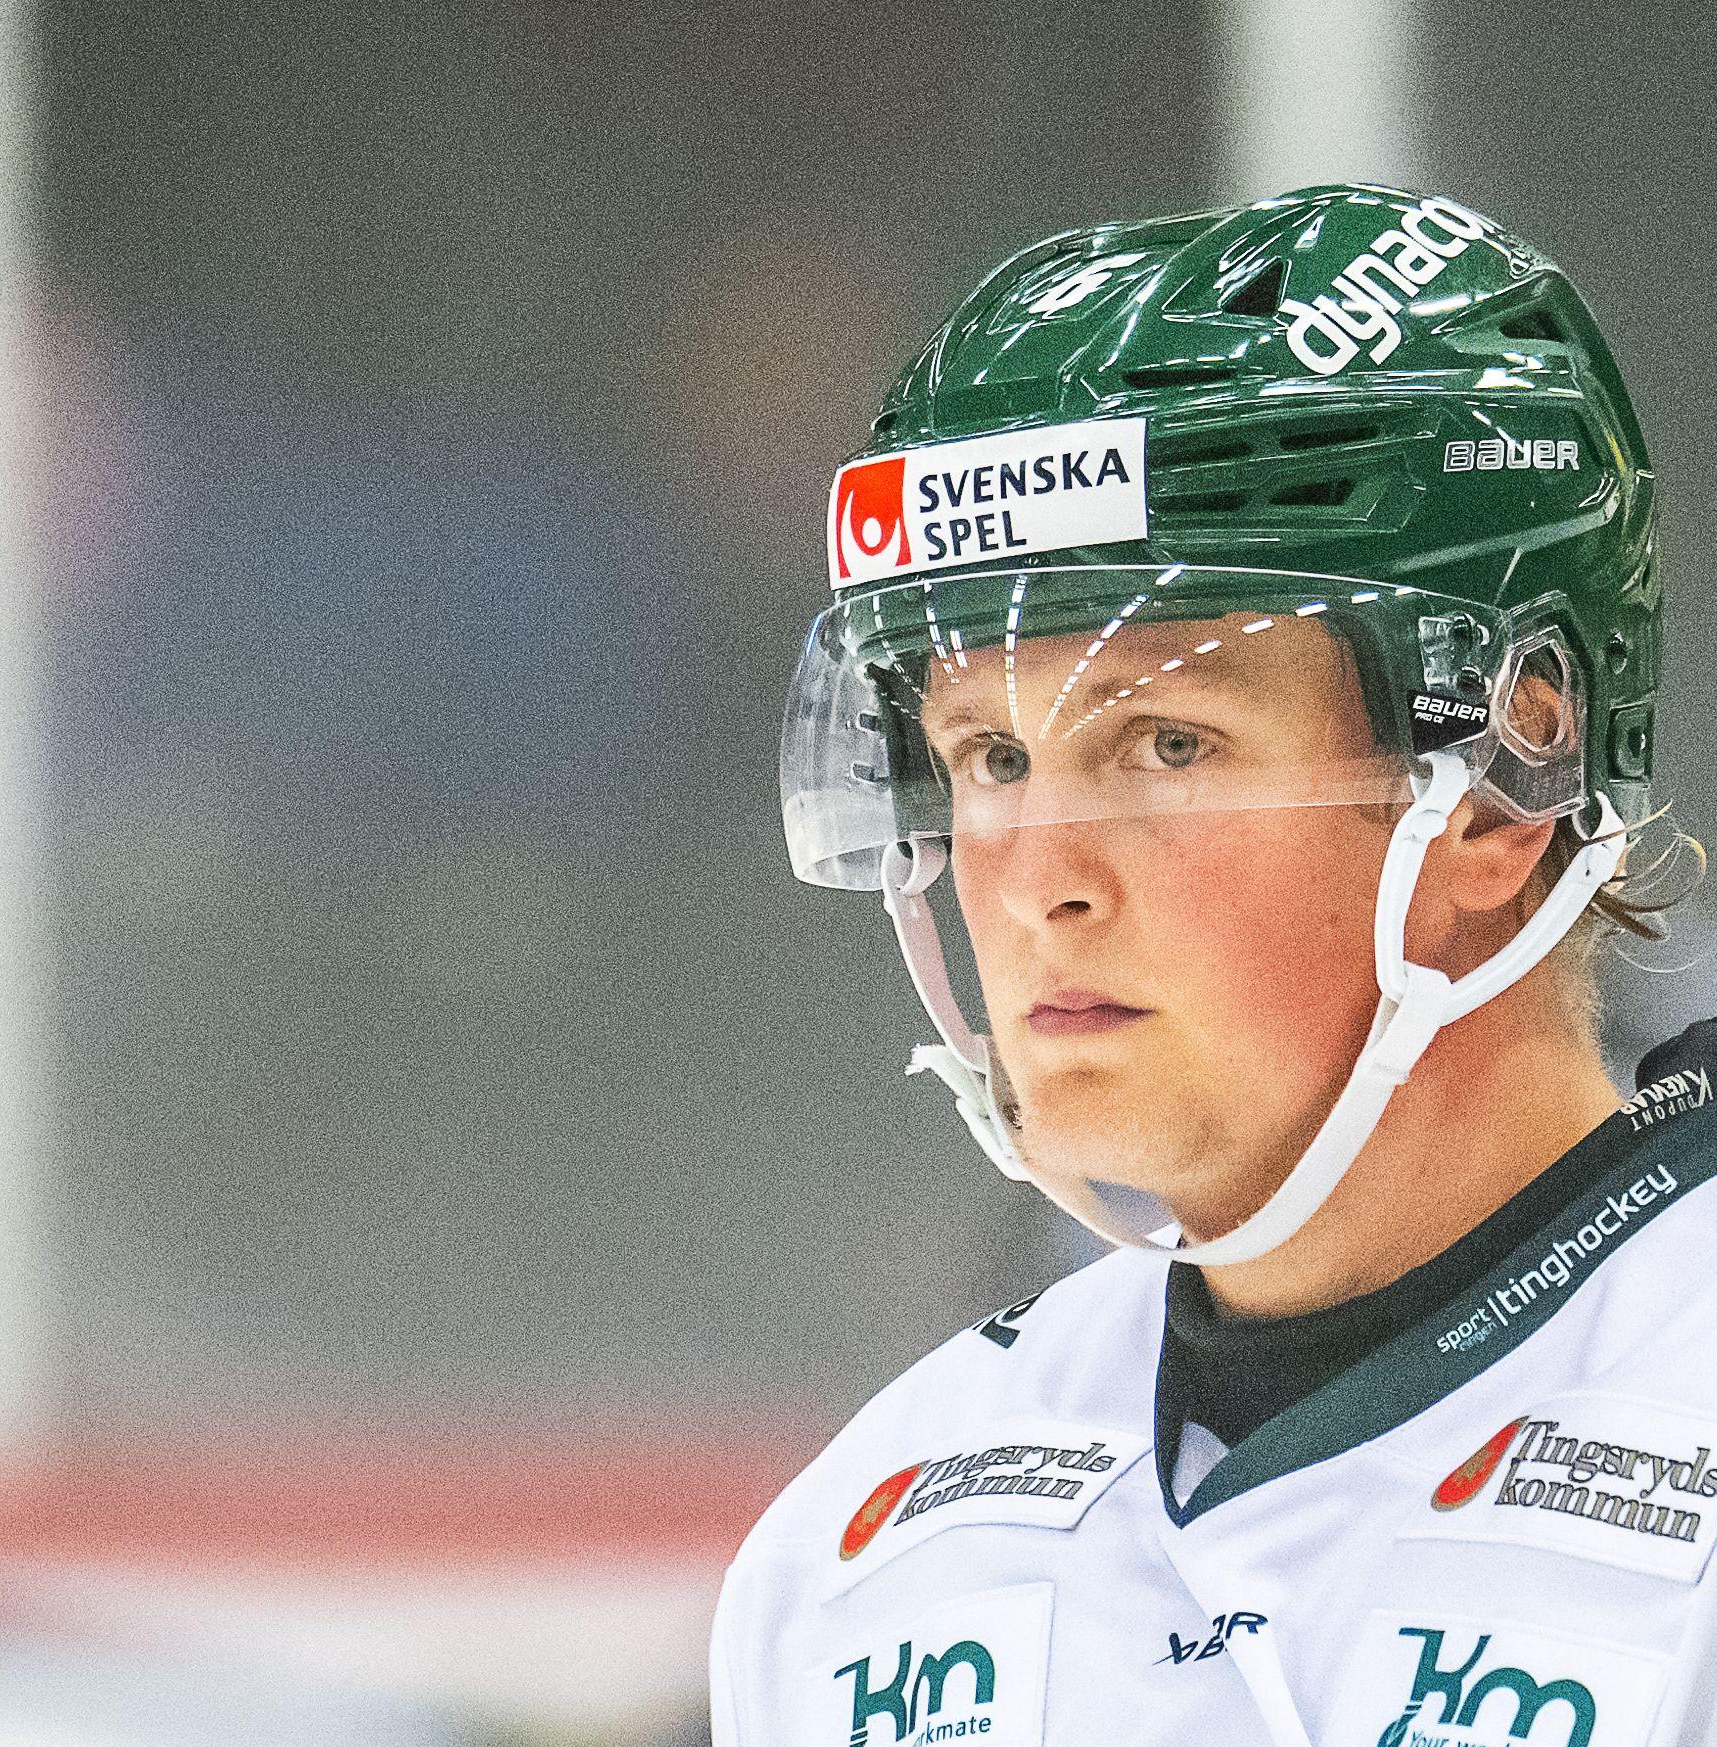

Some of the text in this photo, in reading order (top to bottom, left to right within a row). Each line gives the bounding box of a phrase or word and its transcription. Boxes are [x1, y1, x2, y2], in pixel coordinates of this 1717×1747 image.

[919, 448, 1131, 514] SVENSKA
[1443, 438, 1580, 473] BAUER
[924, 510, 1028, 562] SPEL
[1412, 695, 1488, 722] BAUER
[1436, 1164, 1679, 1354] sport tinghockey
[916, 1442, 1117, 1492] Tingsryds
[892, 1472, 1084, 1527] kommun
[1494, 1457, 1701, 1543] kommun
